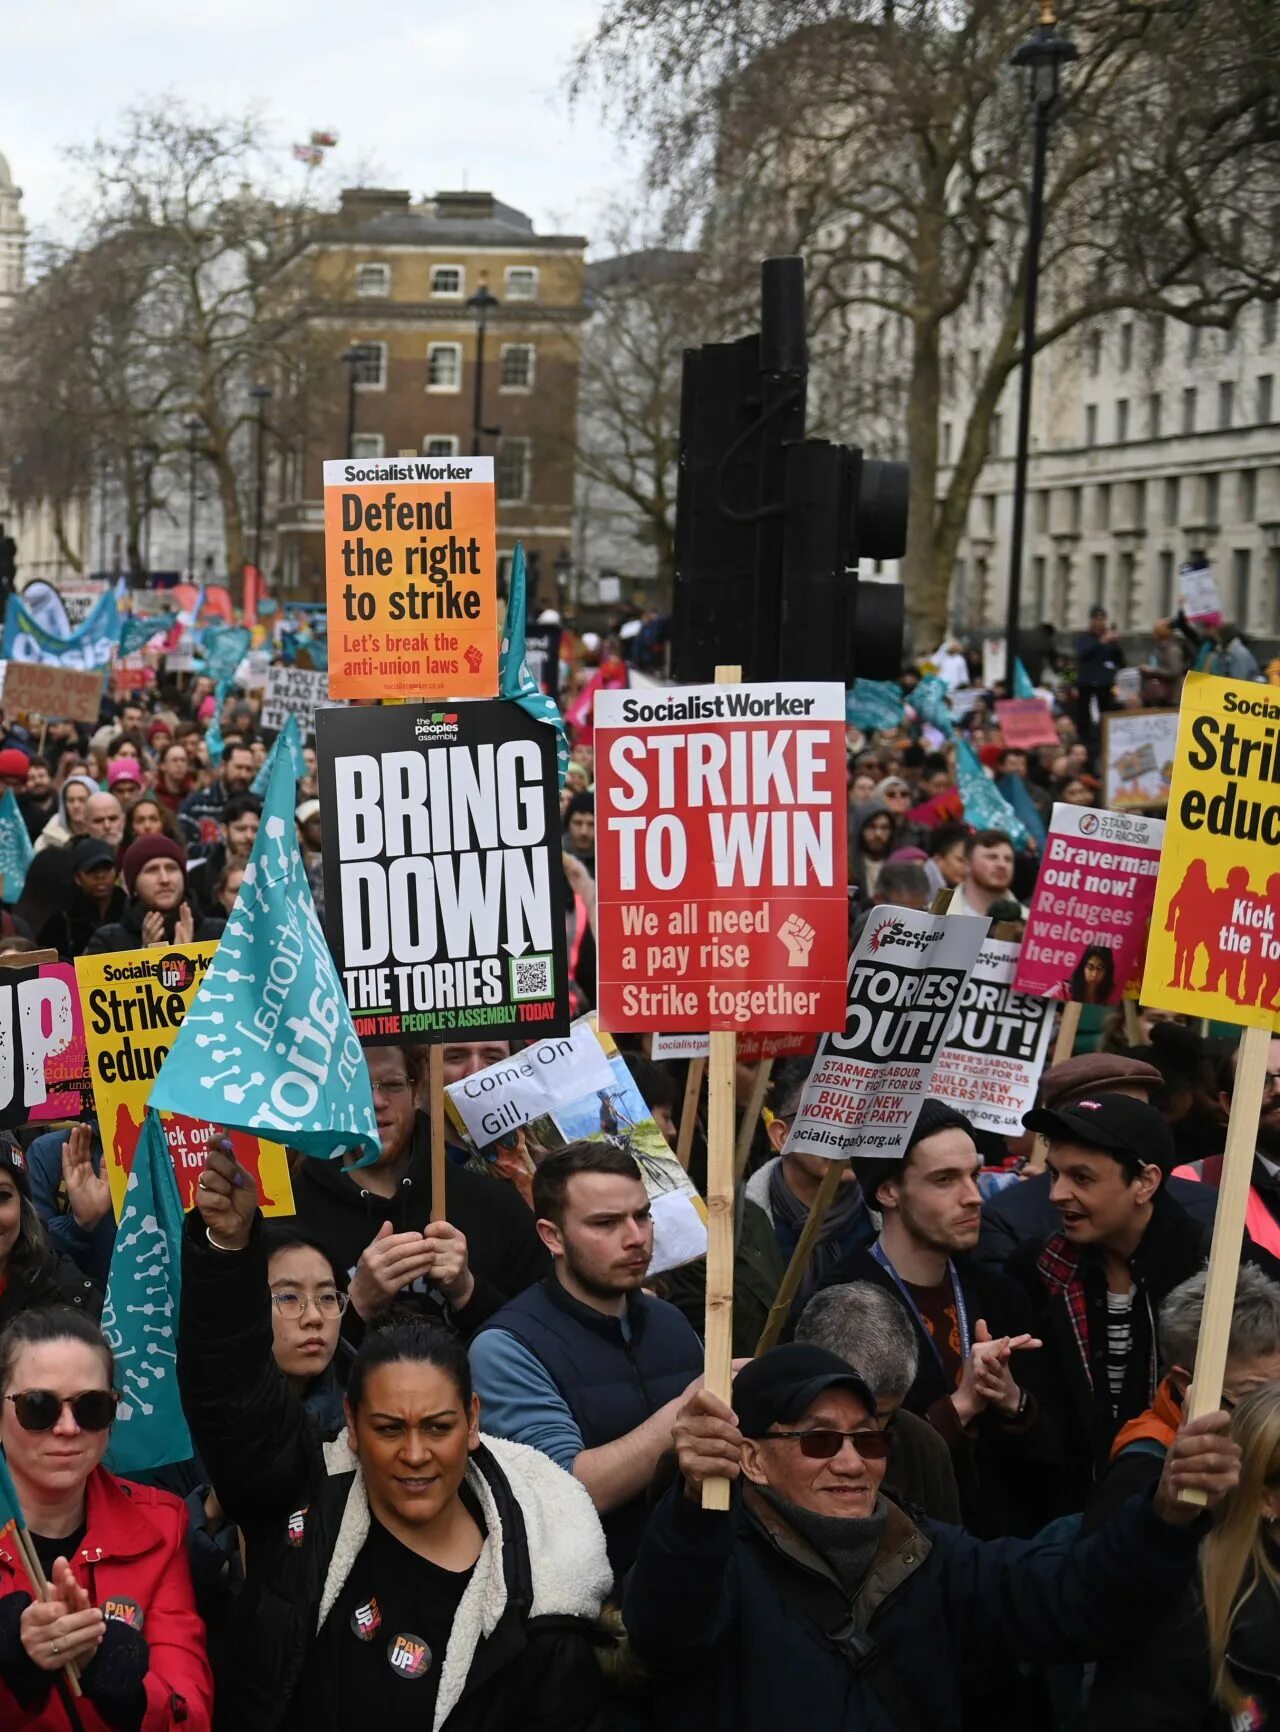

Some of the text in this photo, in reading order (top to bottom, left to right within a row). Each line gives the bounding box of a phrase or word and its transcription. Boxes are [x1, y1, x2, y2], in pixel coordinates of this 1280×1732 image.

[345, 463, 473, 482] Socialist Worker
[342, 491, 452, 532] Defend
[341, 536, 481, 584] the right
[342, 580, 481, 621] to strike
[344, 633, 459, 653] Let's break the
[344, 656, 459, 676] anti-union laws
[416, 717, 430, 726] the
[623, 693, 815, 723] Socialist Worker
[415, 723, 459, 736] peoples
[418, 732, 457, 742] assembly
[609, 729, 832, 812] STRIKE
[334, 740, 546, 861] BRING
[1100, 827, 1149, 844] TO RACISM
[1101, 817, 1148, 832] STAND UP
[608, 811, 834, 891] TO WIN
[1049, 838, 1159, 877] Braverman
[1043, 868, 1137, 898] out now!
[340, 846, 553, 968] DOWN
[620, 902, 770, 936] We all need
[1037, 891, 1134, 926] Refugees
[1232, 899, 1275, 930] Kick
[890, 922, 944, 942] Socialist
[1033, 920, 1124, 949] welcome
[1220, 926, 1251, 953] the
[161, 960, 186, 972] PAY
[622, 937, 750, 976] a pay rise
[1025, 939, 1076, 967] here
[343, 957, 503, 1012] THE TORIES
[850, 967, 959, 1008] TORIES
[89, 986, 185, 1035] Strike
[622, 983, 820, 1022] Strike together
[378, 1001, 556, 1034] THE PEOPLE'S ASSEMBLY TODAY
[831, 1004, 945, 1057] OUT!
[463, 1040, 574, 1100] Come On
[984, 1058, 1024, 1073] LABOUR
[992, 1069, 1011, 1080] FOR
[1014, 1074, 1029, 1084] US
[812, 1073, 922, 1091] DOESN'T FOR US
[931, 1073, 1011, 1094] BUILD NEW
[818, 1091, 903, 1111] BUILD NEW
[980, 1092, 1024, 1108] PARTY
[481, 1099, 531, 1136] Gill,
[871, 1111, 912, 1124] PARTY
[191, 1124, 216, 1144] out
[105, 1601, 136, 1619] PAY
[395, 1636, 425, 1654] PAY
